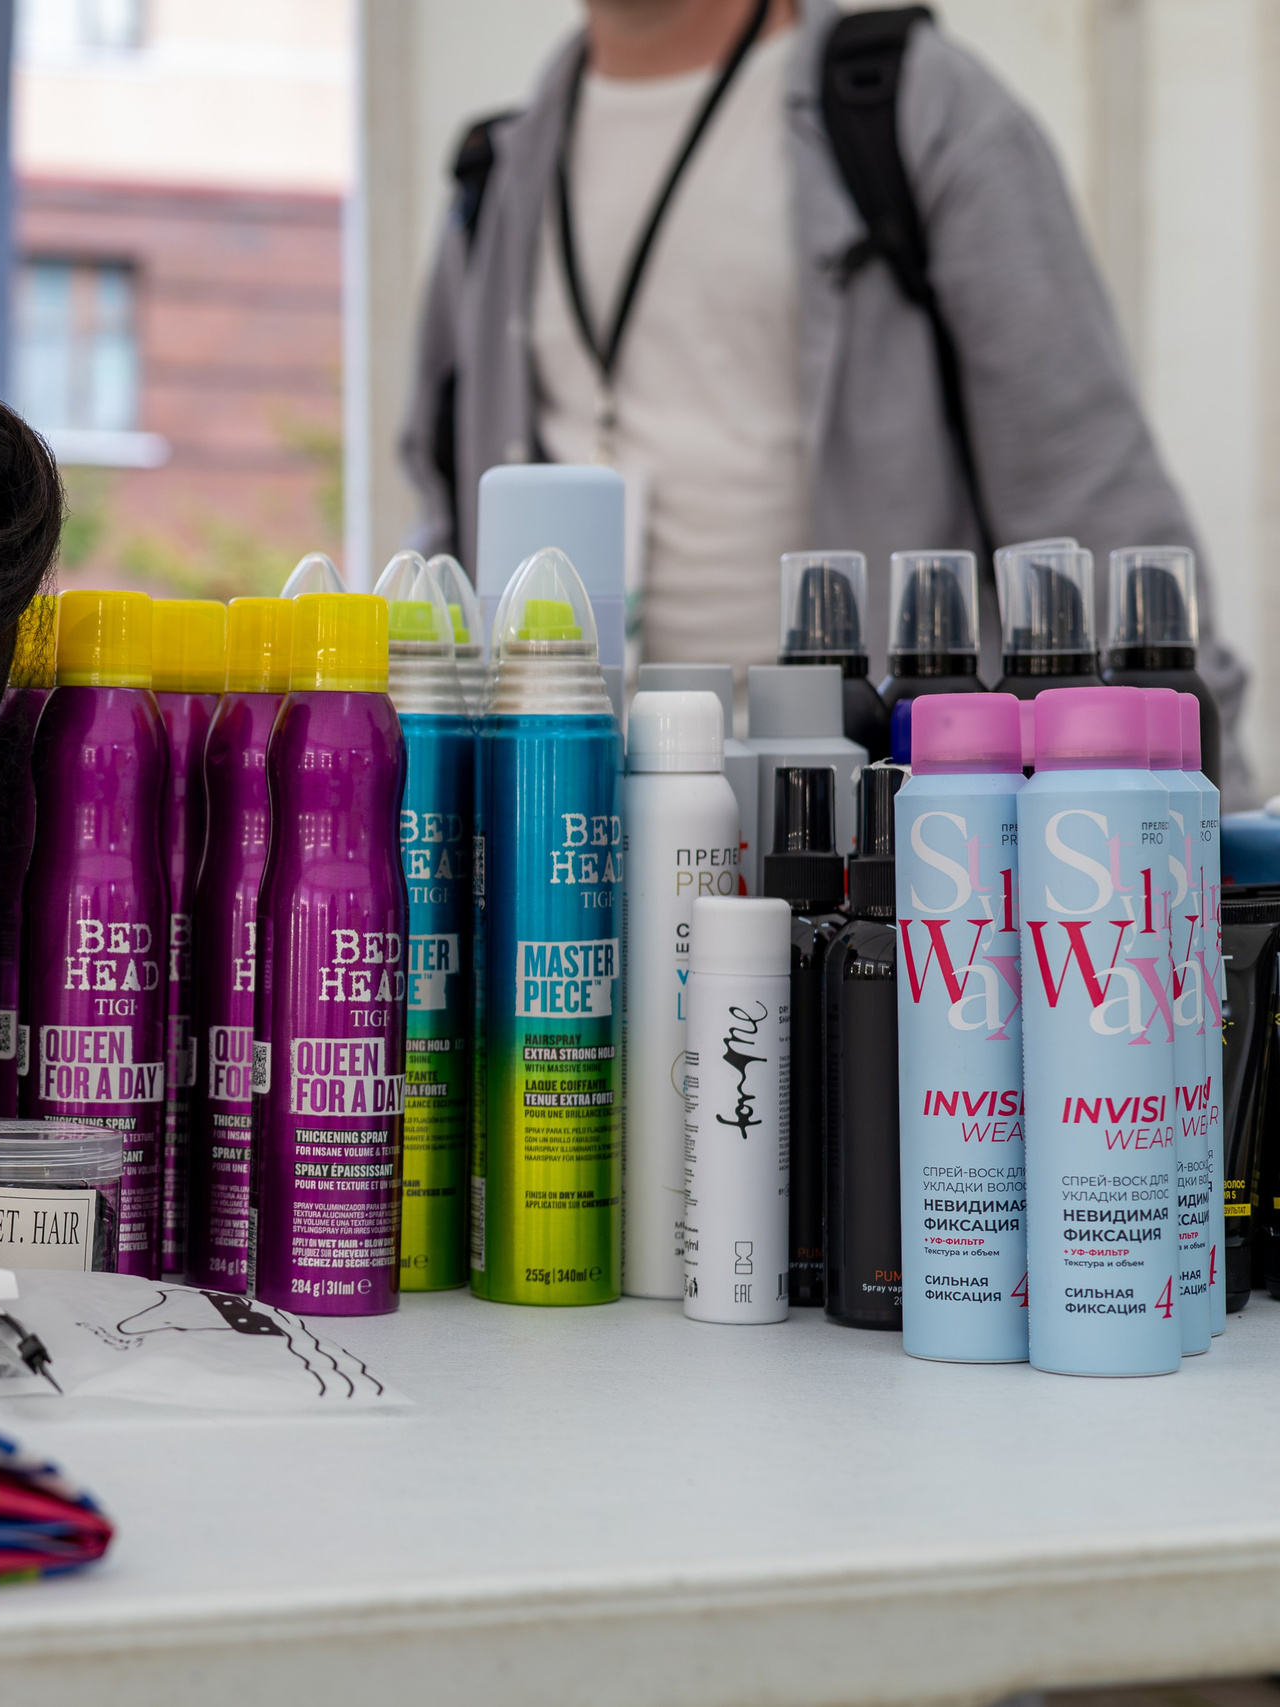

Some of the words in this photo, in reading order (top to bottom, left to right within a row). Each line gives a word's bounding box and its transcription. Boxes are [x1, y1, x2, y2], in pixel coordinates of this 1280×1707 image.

[400, 810, 462, 842] BED
[561, 813, 620, 847] BED
[1142, 821, 1169, 830] ПРЕЛЕС
[1142, 833, 1163, 844] PRO
[677, 848, 738, 866] ПРЕЛЕ
[550, 851, 623, 884] HEAD
[677, 871, 733, 896] PRO
[410, 887, 447, 903] TIGI
[580, 892, 612, 908] TIGI
[76, 919, 152, 953] BED
[331, 929, 402, 964] BED
[525, 945, 613, 977] MASTER
[64, 956, 159, 991] HEAD
[319, 967, 405, 1002] HEAD
[1026, 921, 1174, 1045] Wax
[95, 999, 135, 1015] TIGI
[350, 1010, 388, 1027] TIGI
[427, 1040, 450, 1051] HOLD
[525, 1034, 581, 1045] HAIRSPRAY
[46, 1029, 125, 1064] QUEEN
[524, 1048, 557, 1059] EXTRA
[559, 1048, 596, 1059] STRONG
[598, 1047, 614, 1059] HOLD
[297, 1041, 378, 1076] QUEEN
[409, 1055, 431, 1063] SHINE
[525, 1064, 545, 1072] WITH
[547, 1064, 580, 1072] MASSIVE
[582, 1063, 602, 1072] SHINE
[45, 1065, 89, 1099] FOR
[96, 1066, 112, 1099] A
[120, 1066, 157, 1099] DAY
[525, 1080, 557, 1091] LAQUE
[560, 1078, 606, 1091] COIFFANTE
[297, 1077, 345, 1112] FOR
[351, 1080, 366, 1112] A
[373, 1078, 404, 1112] DAY
[420, 1085, 447, 1096] FORTE
[525, 1094, 557, 1105] TENUE
[560, 1094, 590, 1105] EXTRA
[592, 1092, 613, 1105] FORTE
[923, 1091, 1024, 1116] INVISI
[525, 1110, 545, 1118] POUR
[548, 1110, 563, 1118] UNE
[565, 1110, 602, 1118] BRILLANCE
[1062, 1096, 1166, 1123] INVISI
[106, 1118, 137, 1130] SPRAY
[296, 1130, 358, 1143] THICKENING
[360, 1131, 388, 1143] SPRAY
[962, 1122, 1023, 1142] WEA
[1105, 1127, 1173, 1150] WEAR
[213, 1147, 242, 1160] SPRAY
[296, 1146, 310, 1155] FOR
[313, 1146, 341, 1156] INSANE
[344, 1147, 374, 1156] VOLUME
[232, 1164, 247, 1173] UNE
[295, 1164, 328, 1176] SPRAY
[331, 1163, 393, 1177] ÉPAISSISSANT
[923, 1166, 1004, 1177] СПРЕЙ-ВОСК
[295, 1180, 316, 1189] POUR
[318, 1181, 334, 1190] UNE
[336, 1181, 369, 1190] TEXTURE
[371, 1181, 378, 1190] ET
[1062, 1175, 1148, 1186] СПРЕЙ-ВОСК
[1150, 1174, 1168, 1186] ДЛЯ
[923, 1181, 982, 1193] УКЛАДКИ
[988, 1182, 1027, 1192] ВОЛОС
[548, 1191, 557, 1199] ON
[559, 1191, 575, 1199] DRY
[577, 1190, 594, 1198] HAIR
[1062, 1191, 1127, 1203] УКЛАДКИ
[1132, 1189, 1169, 1200] ВОЛОС
[1232, 1191, 1236, 1199] 5
[293, 1202, 313, 1210] SPRAY
[315, 1203, 365, 1211] VOLUMINIZADOR
[525, 1200, 566, 1208] APPLICATION
[568, 1201, 580, 1209] SUR
[924, 1199, 1027, 1214] НЕВИДИМАЯ
[1225, 1207, 1246, 1215] ЗУЛЬТАТ
[1064, 1208, 1168, 1224] НЕВИДИМАЯ
[32, 1211, 80, 1245] HAIR
[293, 1226, 339, 1234] STYLINGSPRAY
[924, 1218, 1019, 1232] ФИКСАЦИЯ
[930, 1237, 984, 1245] УФ-ФИЛЬТР
[1064, 1228, 1161, 1243] ФИКСАЦИЯ
[293, 1238, 308, 1246] APPLY
[318, 1239, 336, 1248] WET
[338, 1240, 357, 1248] HAIR
[365, 1239, 383, 1247] BLOW
[321, 1249, 331, 1257] SUR
[333, 1249, 369, 1258] CHEVEUX
[924, 1247, 960, 1257] Текстура
[210, 1258, 226, 1270] 284
[298, 1257, 330, 1267] SÉCHEZ
[332, 1259, 343, 1267] AU
[1064, 1259, 1104, 1268] Текстура
[526, 1269, 550, 1285] 255g
[557, 1268, 587, 1282] 340ml
[875, 1270, 902, 1281] PUM
[925, 1275, 988, 1286] СИЛЬНАЯ
[292, 1279, 311, 1293] 284
[863, 1284, 885, 1293] Spray
[925, 1292, 1001, 1303] ФИКСАЦИЯ
[1065, 1288, 1133, 1298] СИЛЬНАЯ
[1154, 1275, 1173, 1319] 4
[1065, 1303, 1145, 1315] ФИКСАЦИЯ
